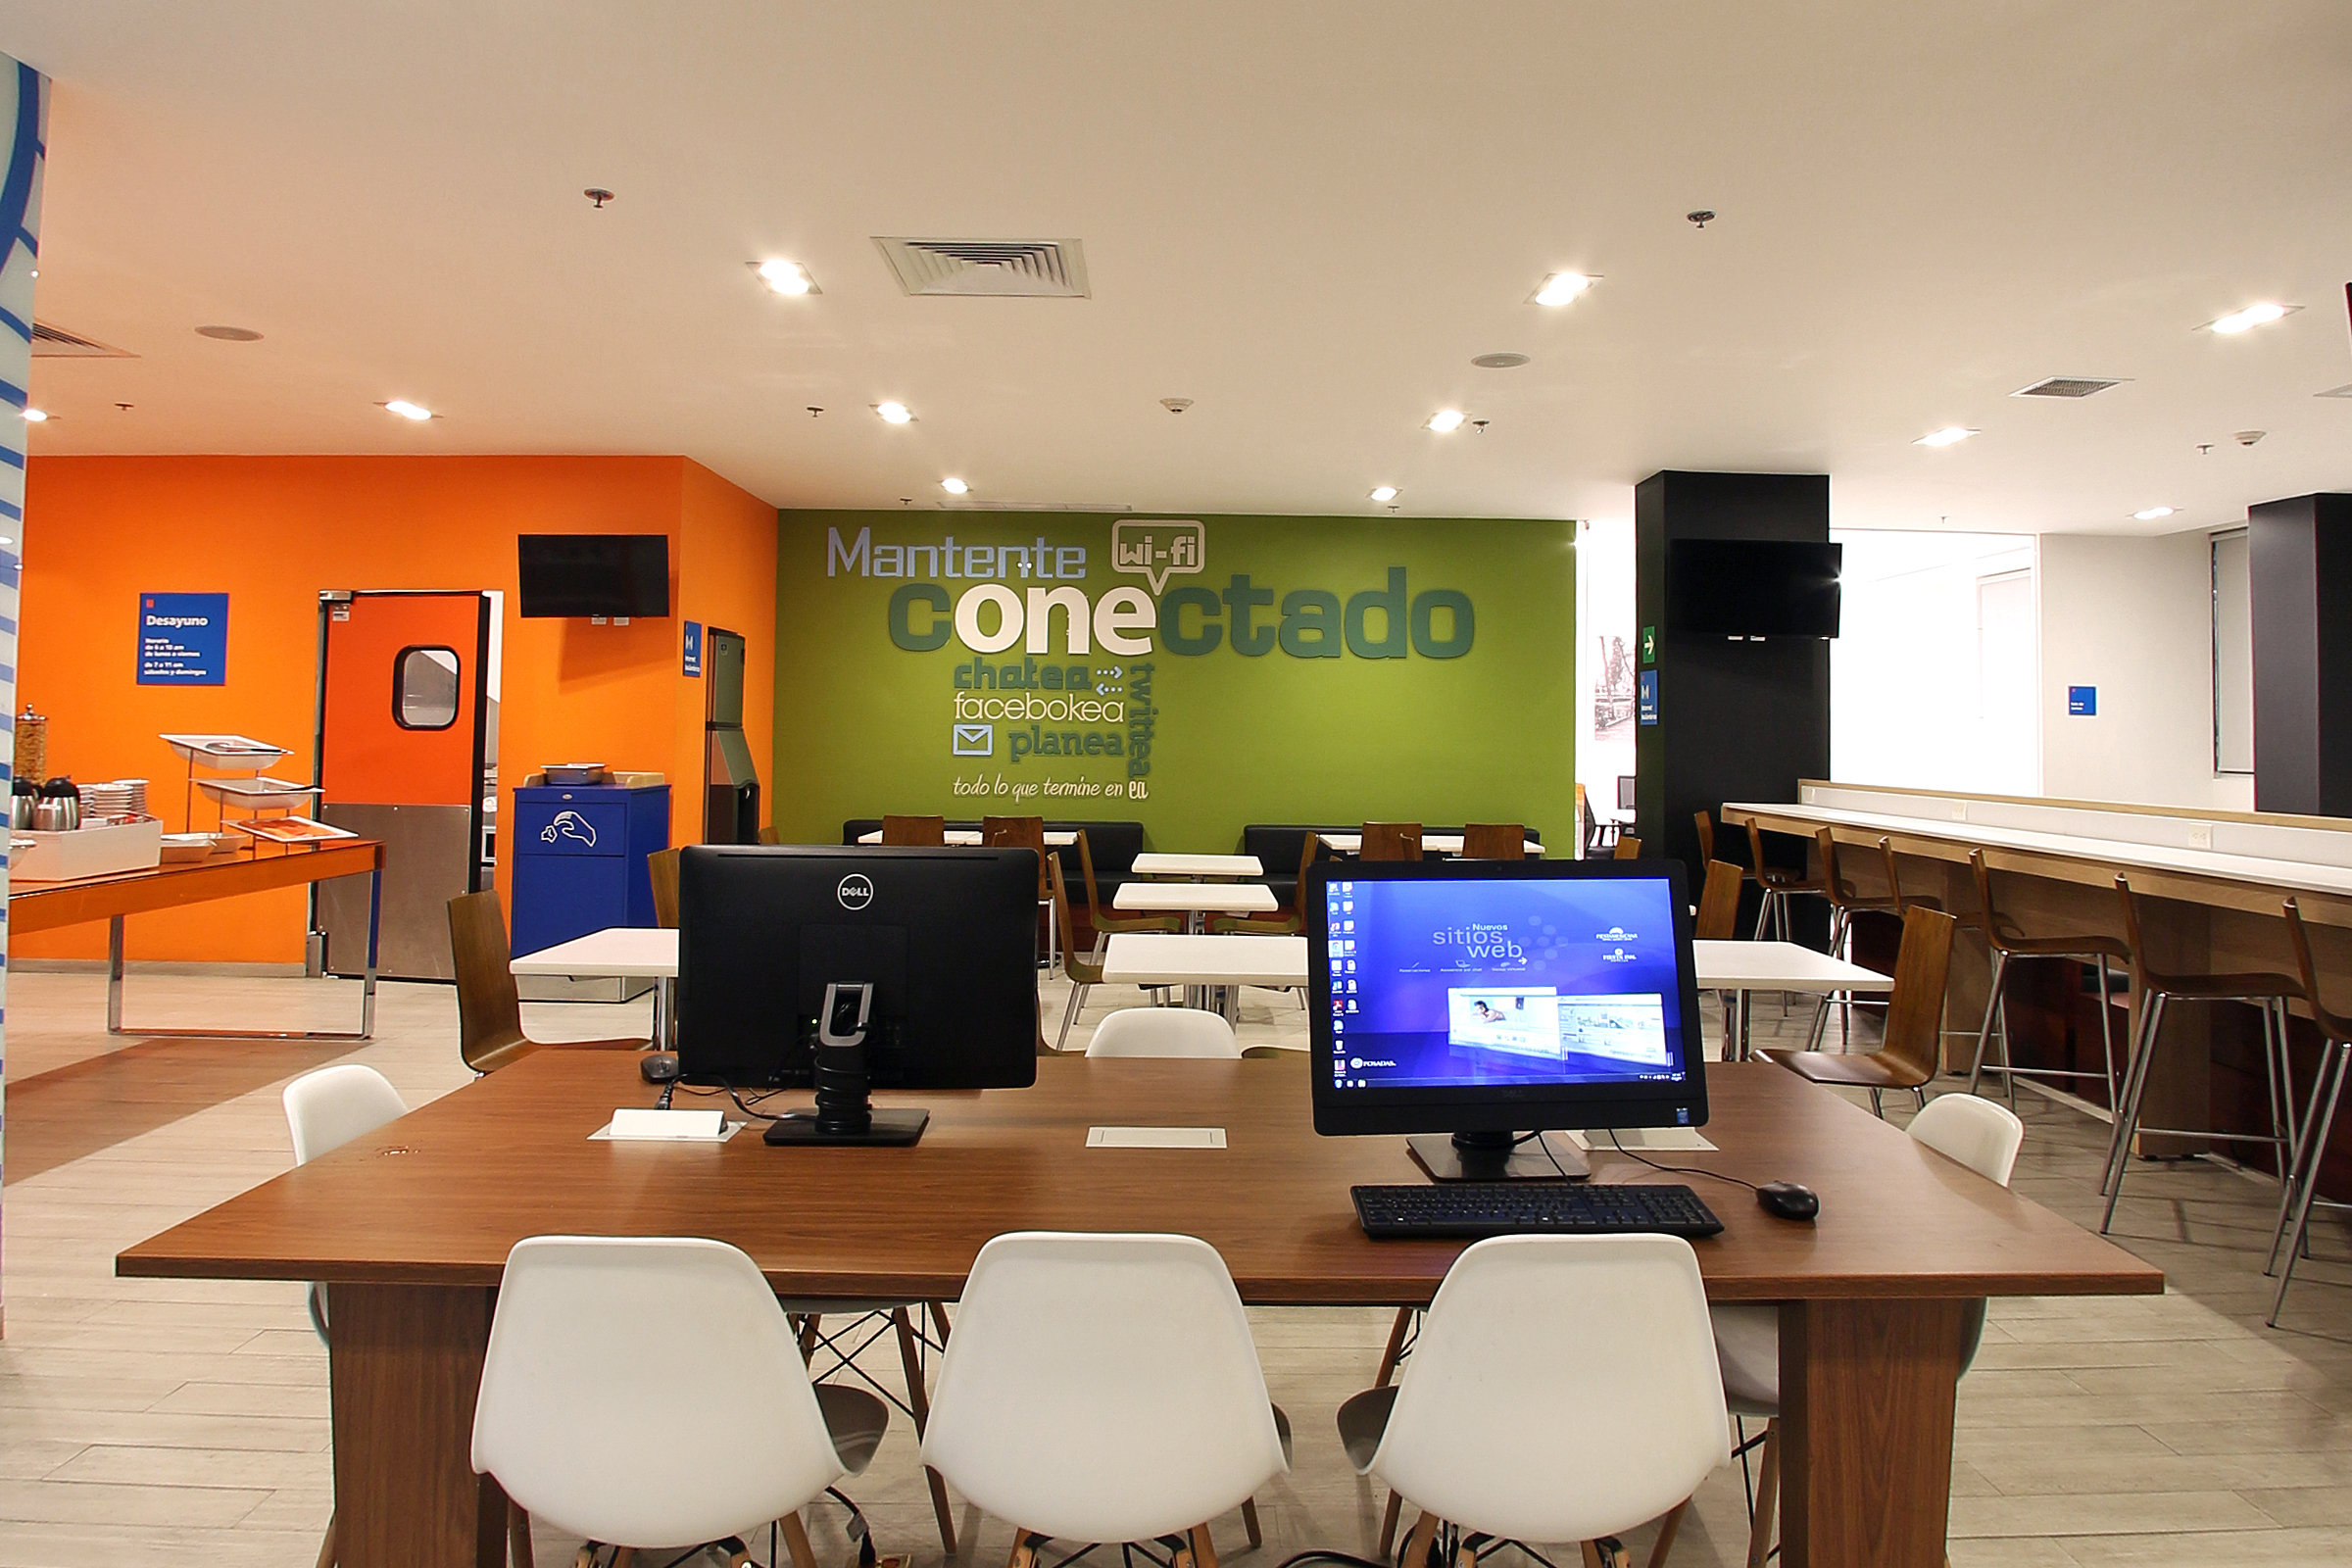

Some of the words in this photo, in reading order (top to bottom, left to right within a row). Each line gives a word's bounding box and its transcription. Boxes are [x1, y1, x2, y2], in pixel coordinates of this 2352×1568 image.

[827, 526, 1087, 579] Mantente
[1119, 535, 1196, 565] wi-fi
[146, 615, 209, 628] Desayuno
[889, 565, 1475, 660] conectado
[954, 657, 1093, 690] chatea
[954, 692, 1125, 723] facebokea
[1008, 725, 1124, 763] planea
[954, 773, 990, 796] todo
[994, 772, 1007, 796] lo
[1011, 780, 1039, 803] que
[1043, 776, 1102, 797] termine
[1104, 783, 1124, 797] en
[1129, 780, 1150, 800] ea
[842, 887, 869, 897] DELL
[1432, 926, 1503, 945] sitios
[1466, 940, 1523, 958] web
